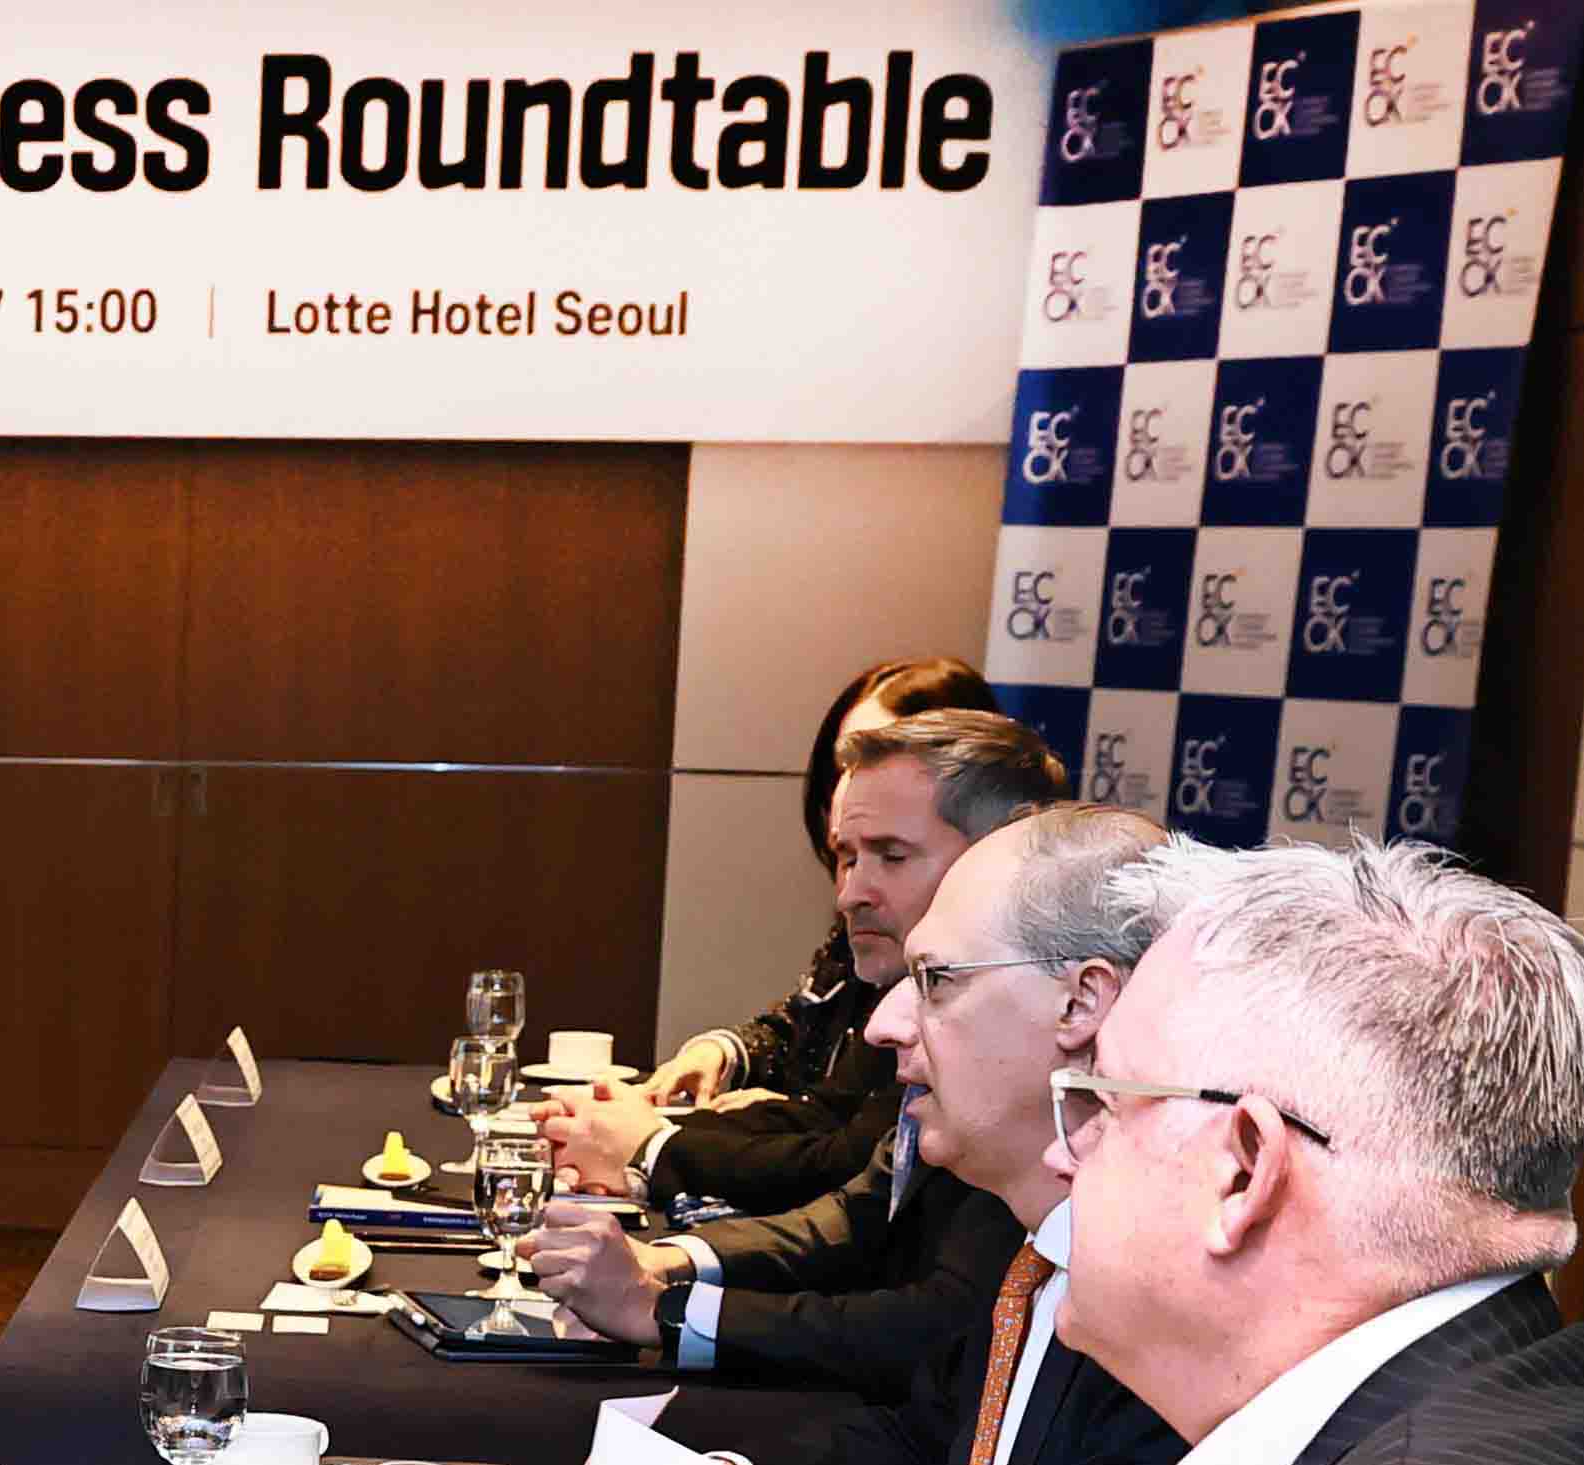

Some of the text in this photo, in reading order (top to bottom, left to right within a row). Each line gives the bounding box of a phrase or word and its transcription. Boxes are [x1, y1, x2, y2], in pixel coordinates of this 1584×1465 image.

[258, 50, 993, 193] Roundtable
[27, 287, 156, 334] 15:00
[266, 288, 391, 335] Lotte
[411, 288, 535, 337] Hotel
[555, 289, 687, 337] Seoul
